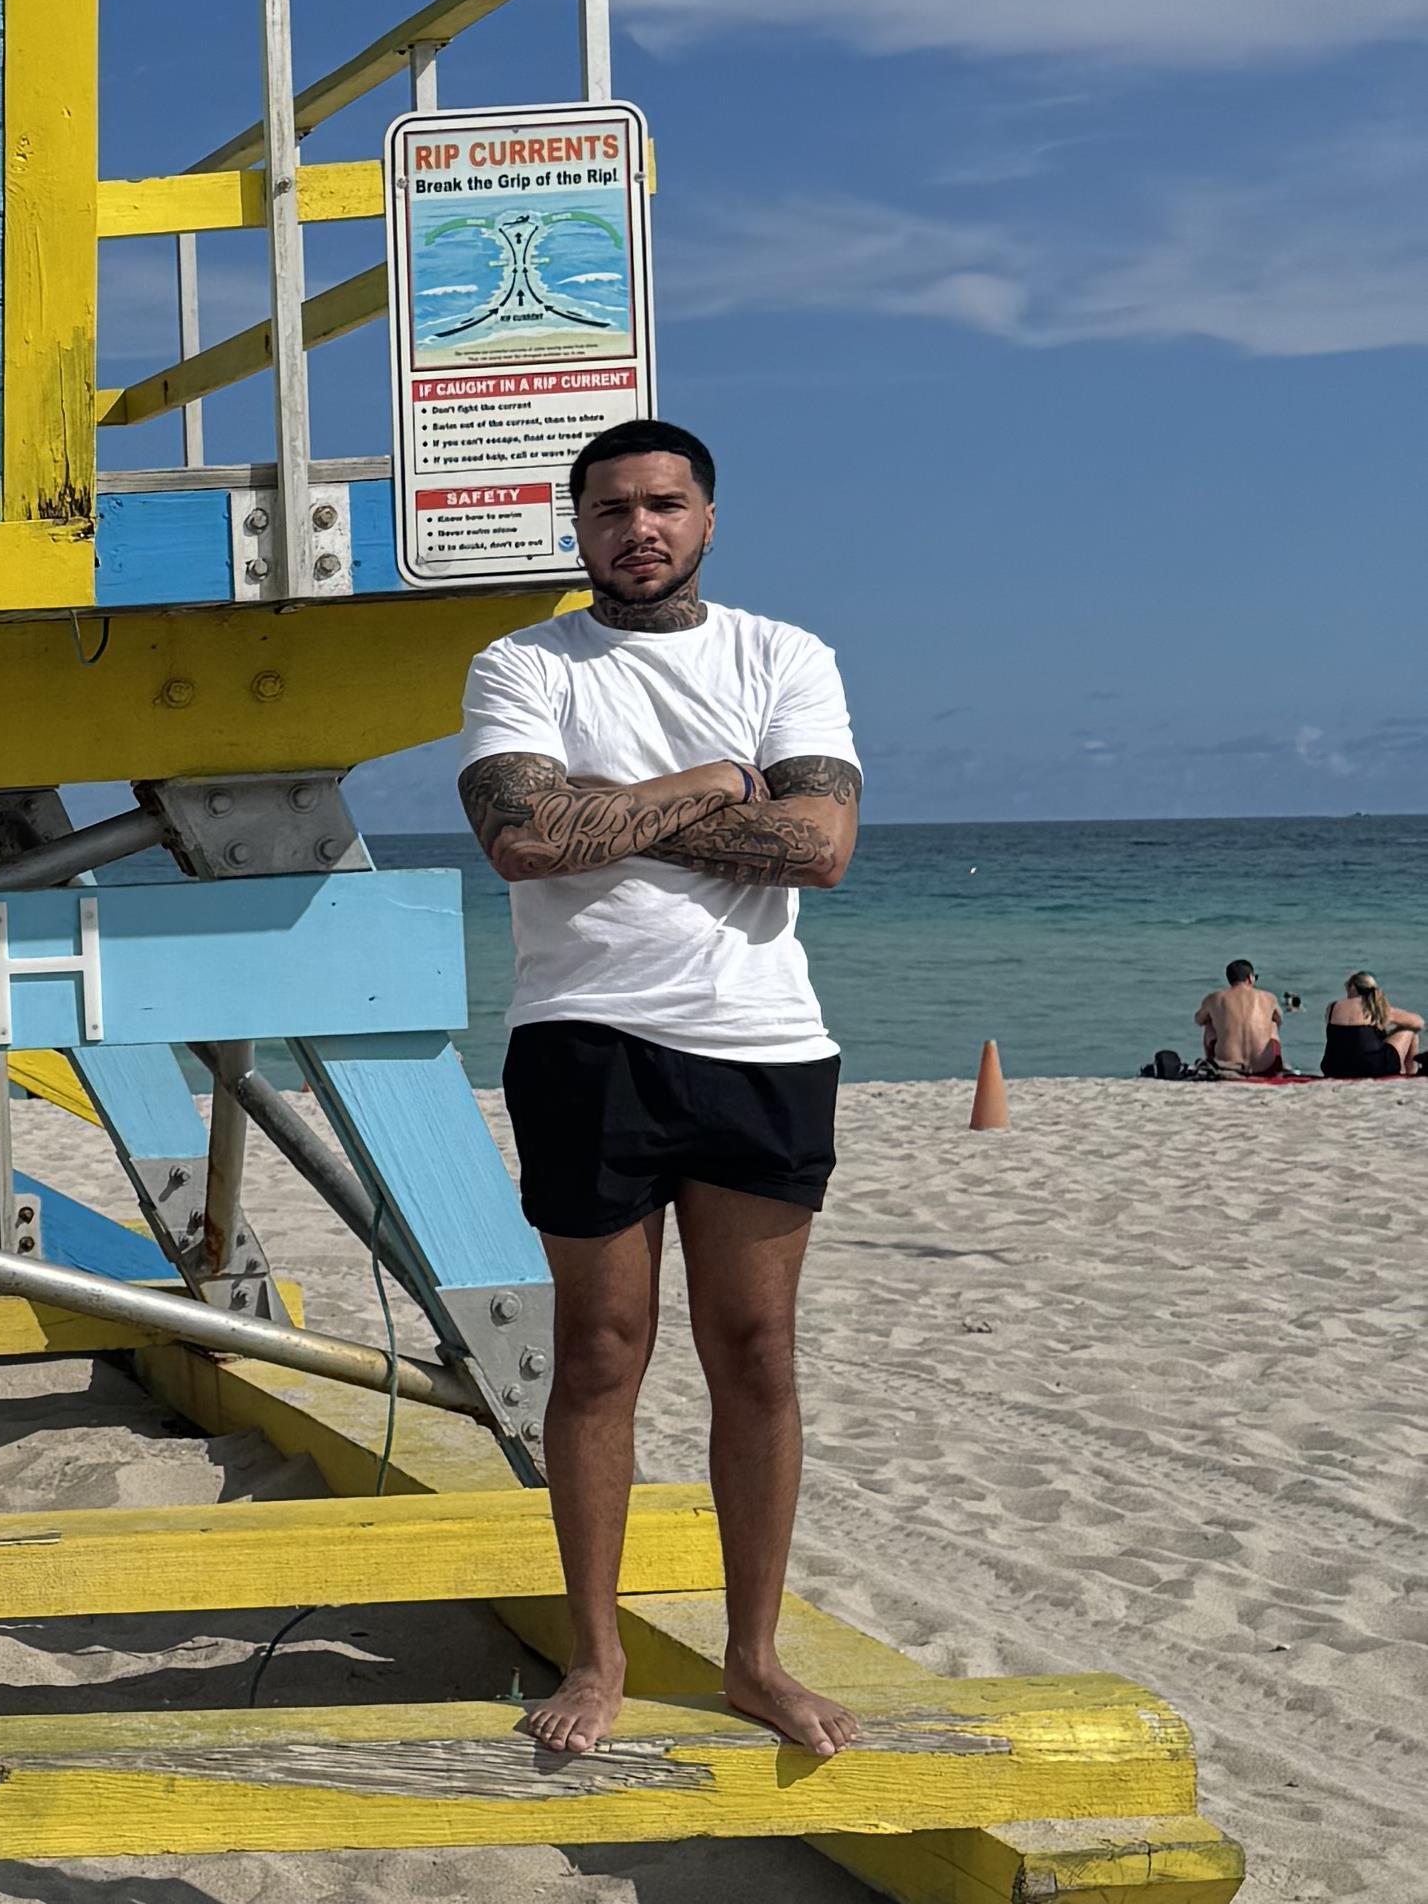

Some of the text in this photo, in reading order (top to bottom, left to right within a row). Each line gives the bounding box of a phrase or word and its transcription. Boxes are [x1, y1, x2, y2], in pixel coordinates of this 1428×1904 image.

[416, 134, 618, 171] RIP CURRENTS
[416, 168, 618, 194] Break the Grip of the Rip!
[419, 373, 629, 397] IF CAUGHT IN A RIP CURRENT
[432, 406, 455, 414] Don't
[457, 404, 478, 414] fight
[498, 402, 531, 410] current
[446, 489, 520, 505] SAFETY
